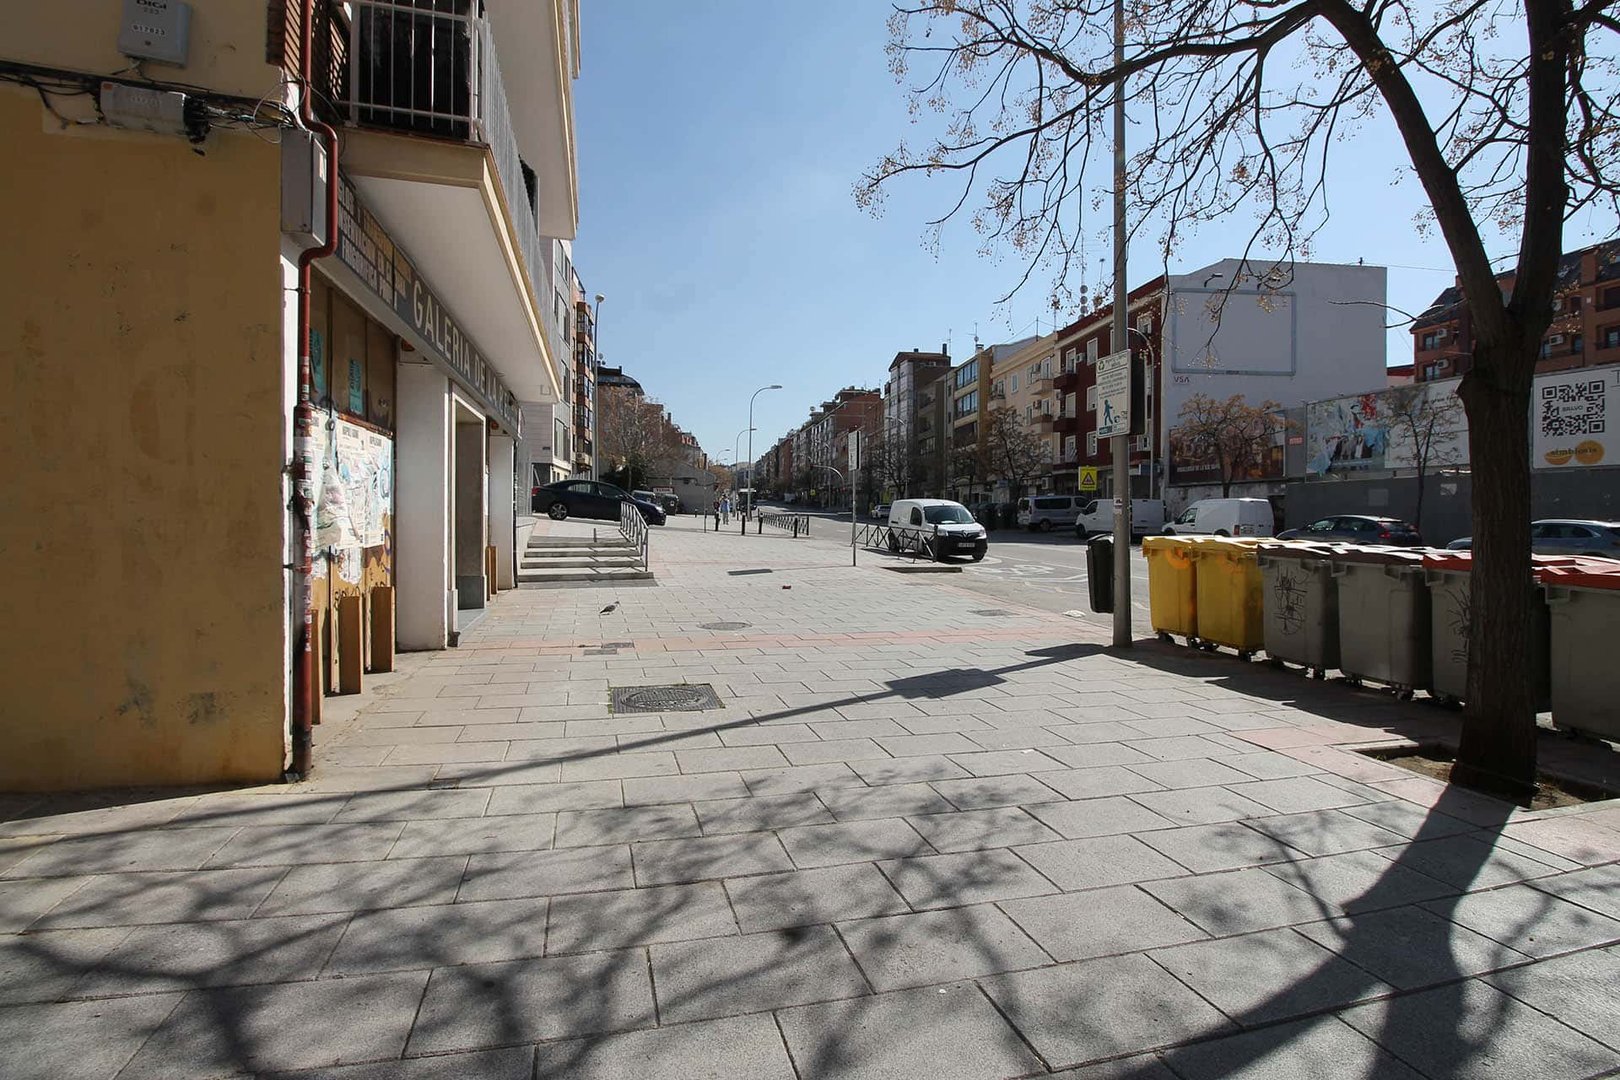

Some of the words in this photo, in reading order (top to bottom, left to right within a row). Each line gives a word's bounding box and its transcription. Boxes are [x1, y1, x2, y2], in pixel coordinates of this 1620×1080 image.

[136, 0, 167, 9] DIGI
[413, 280, 471, 379] GALERIA
[474, 354, 486, 395] DE
